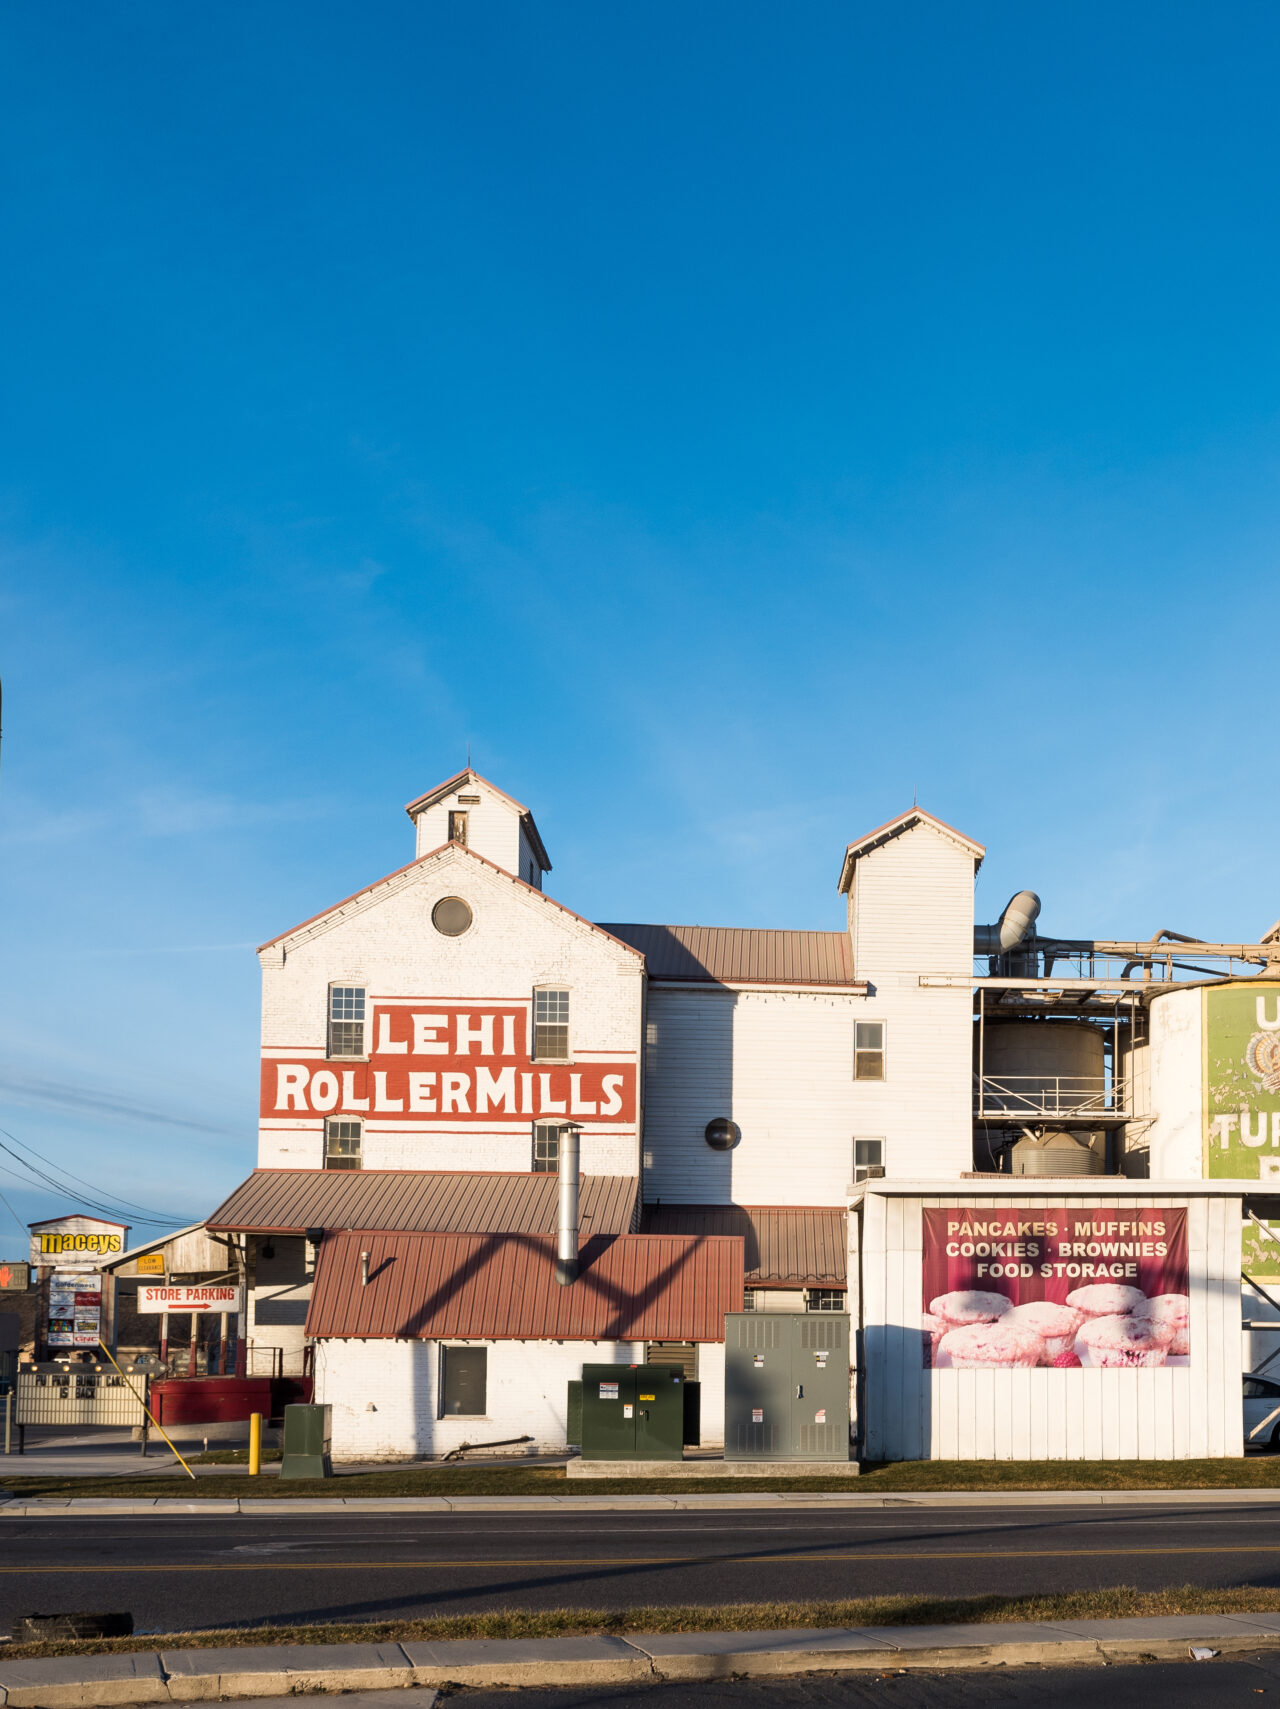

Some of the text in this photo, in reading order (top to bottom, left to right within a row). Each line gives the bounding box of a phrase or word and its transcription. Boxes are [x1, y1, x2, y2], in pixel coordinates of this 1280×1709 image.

[375, 1013, 517, 1056] LEHI
[947, 1221, 1166, 1237] PANCAKES MUFFINS
[33, 1233, 121, 1255] maceys
[945, 1241, 1169, 1257] COOKIES BROWNIES
[976, 1262, 1138, 1278] FOOD STORAGE
[146, 1287, 235, 1301] STORE PARKING
[106, 1375, 126, 1387] CAKE
[60, 1387, 96, 1399] IS BACK
